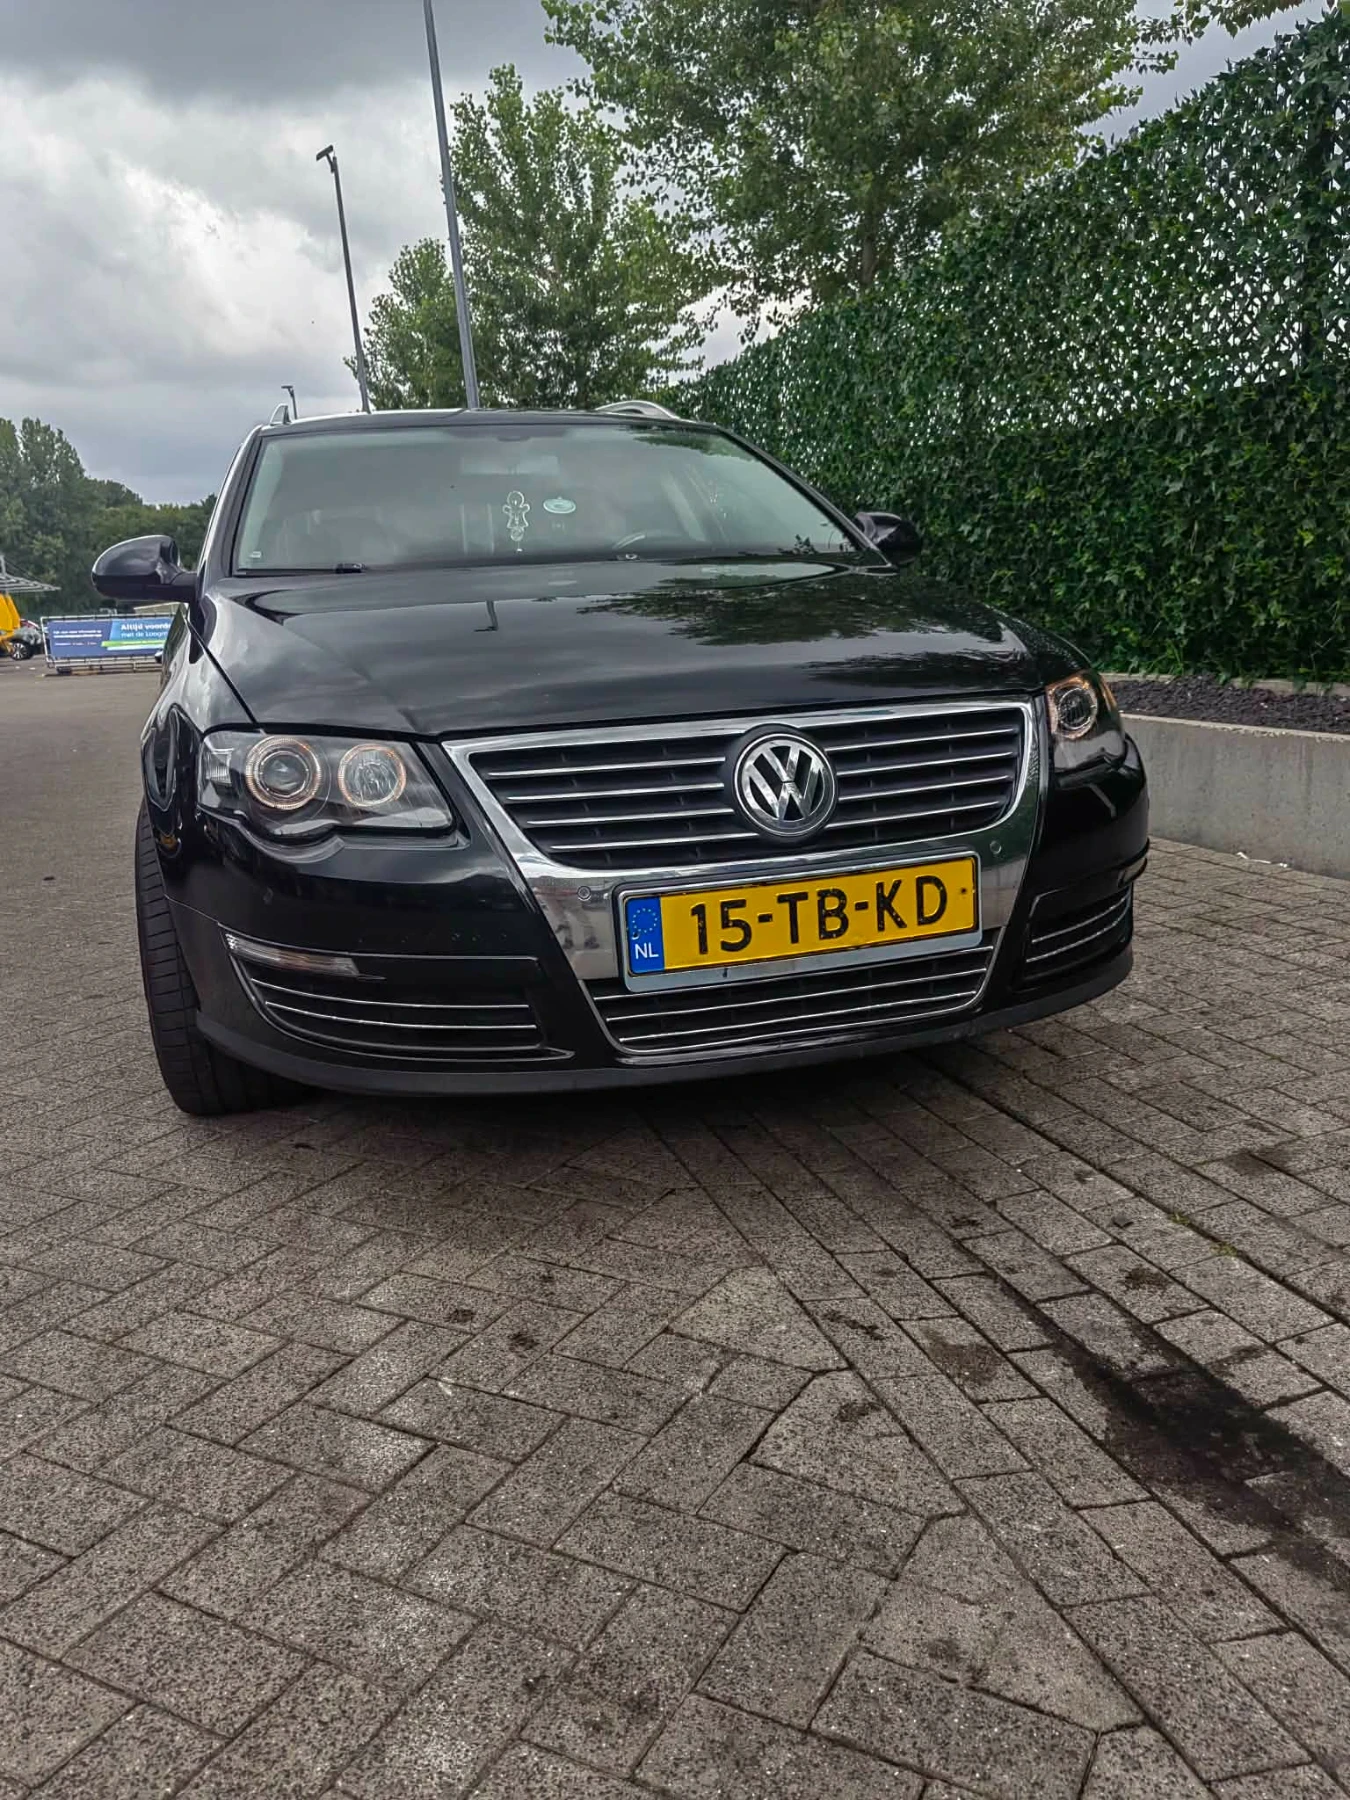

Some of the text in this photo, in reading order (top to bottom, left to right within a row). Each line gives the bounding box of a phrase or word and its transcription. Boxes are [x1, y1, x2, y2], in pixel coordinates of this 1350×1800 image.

[121, 623, 143, 632] Altijd
[741, 739, 829, 829] VW
[690, 875, 947, 954] 15-TB-KD
[635, 943, 659, 960] NL
